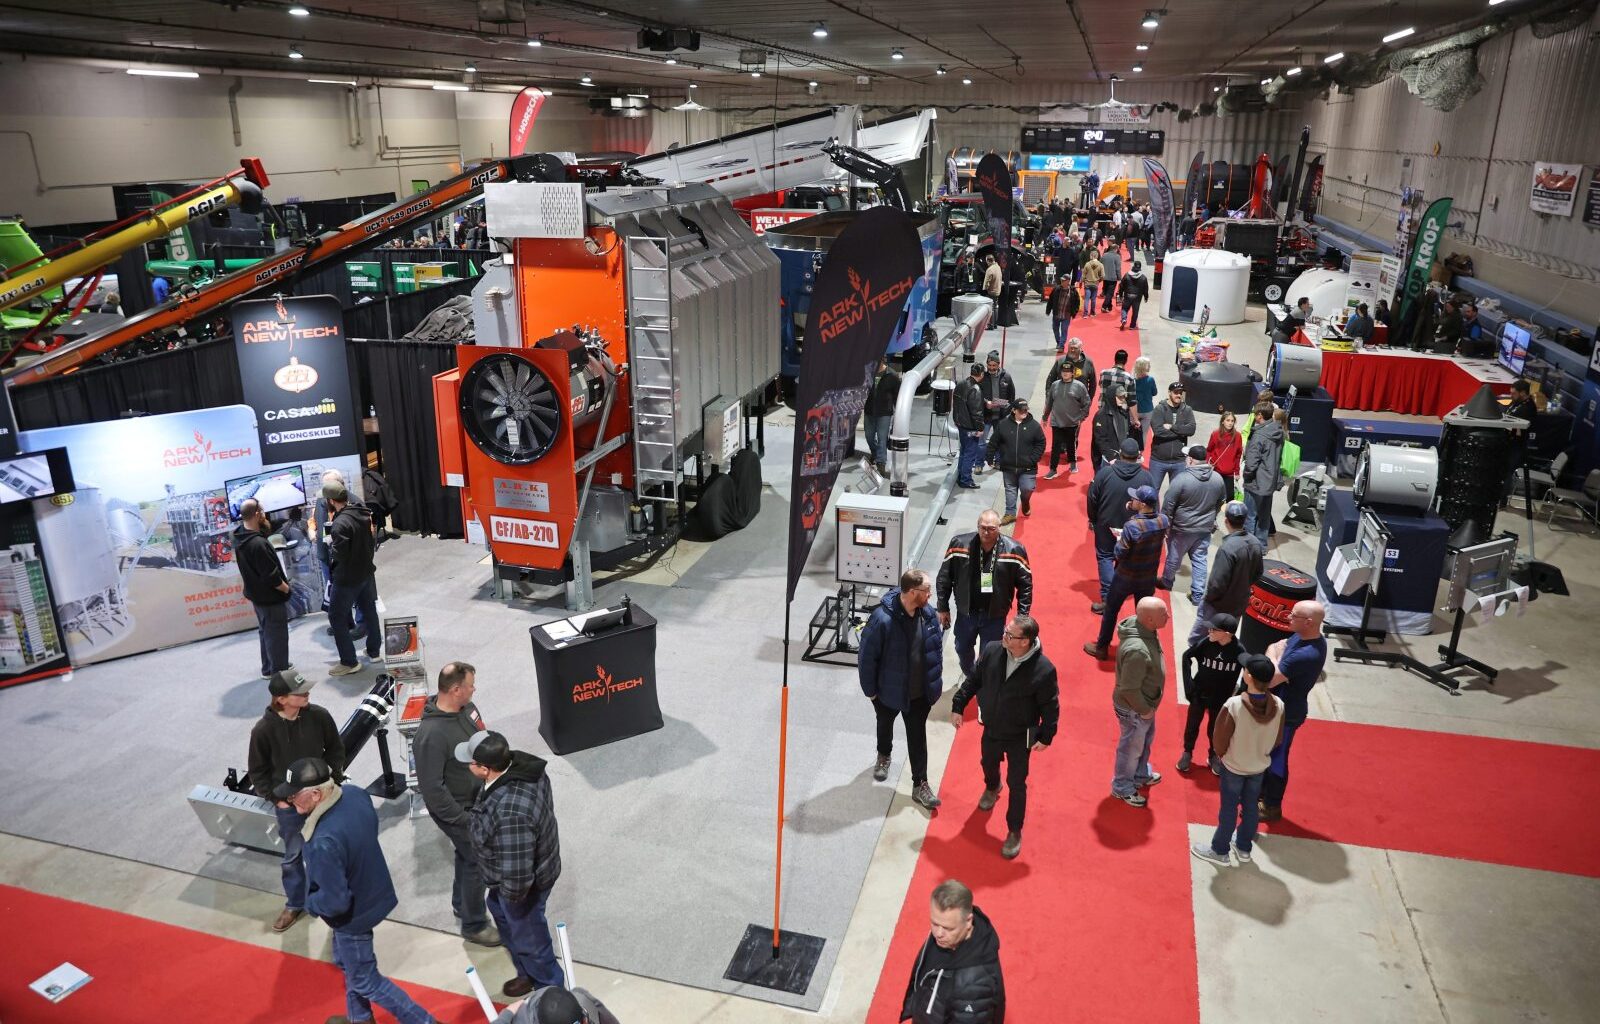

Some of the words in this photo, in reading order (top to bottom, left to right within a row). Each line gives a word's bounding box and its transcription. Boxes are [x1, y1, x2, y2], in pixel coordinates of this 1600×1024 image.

[471, 171, 489, 188] AGI
[188, 198, 214, 220] AGI
[386, 210, 405, 225] 1549
[406, 199, 432, 216] DIESEL
[1415, 217, 1440, 269] KROP
[255, 268, 272, 282] AGI
[21, 277, 46, 293] 13-41
[819, 292, 859, 329] ARK
[821, 305, 864, 344] NEW
[868, 275, 914, 312] TECH
[242, 320, 282, 333] ARK
[244, 330, 288, 344] NEW
[291, 326, 339, 339] TECH
[283, 427, 341, 441] KONGSKILDE
[163, 446, 200, 458] ARK
[164, 456, 204, 468] NEW
[209, 448, 252, 461] TECH
[53, 495, 71, 504] GSI
[495, 521, 554, 543] CF/AB-270
[1202, 657, 1237, 671] JORDAN
[572, 679, 603, 694] ARK
[573, 687, 606, 704] NEW
[609, 676, 643, 693] TECH
